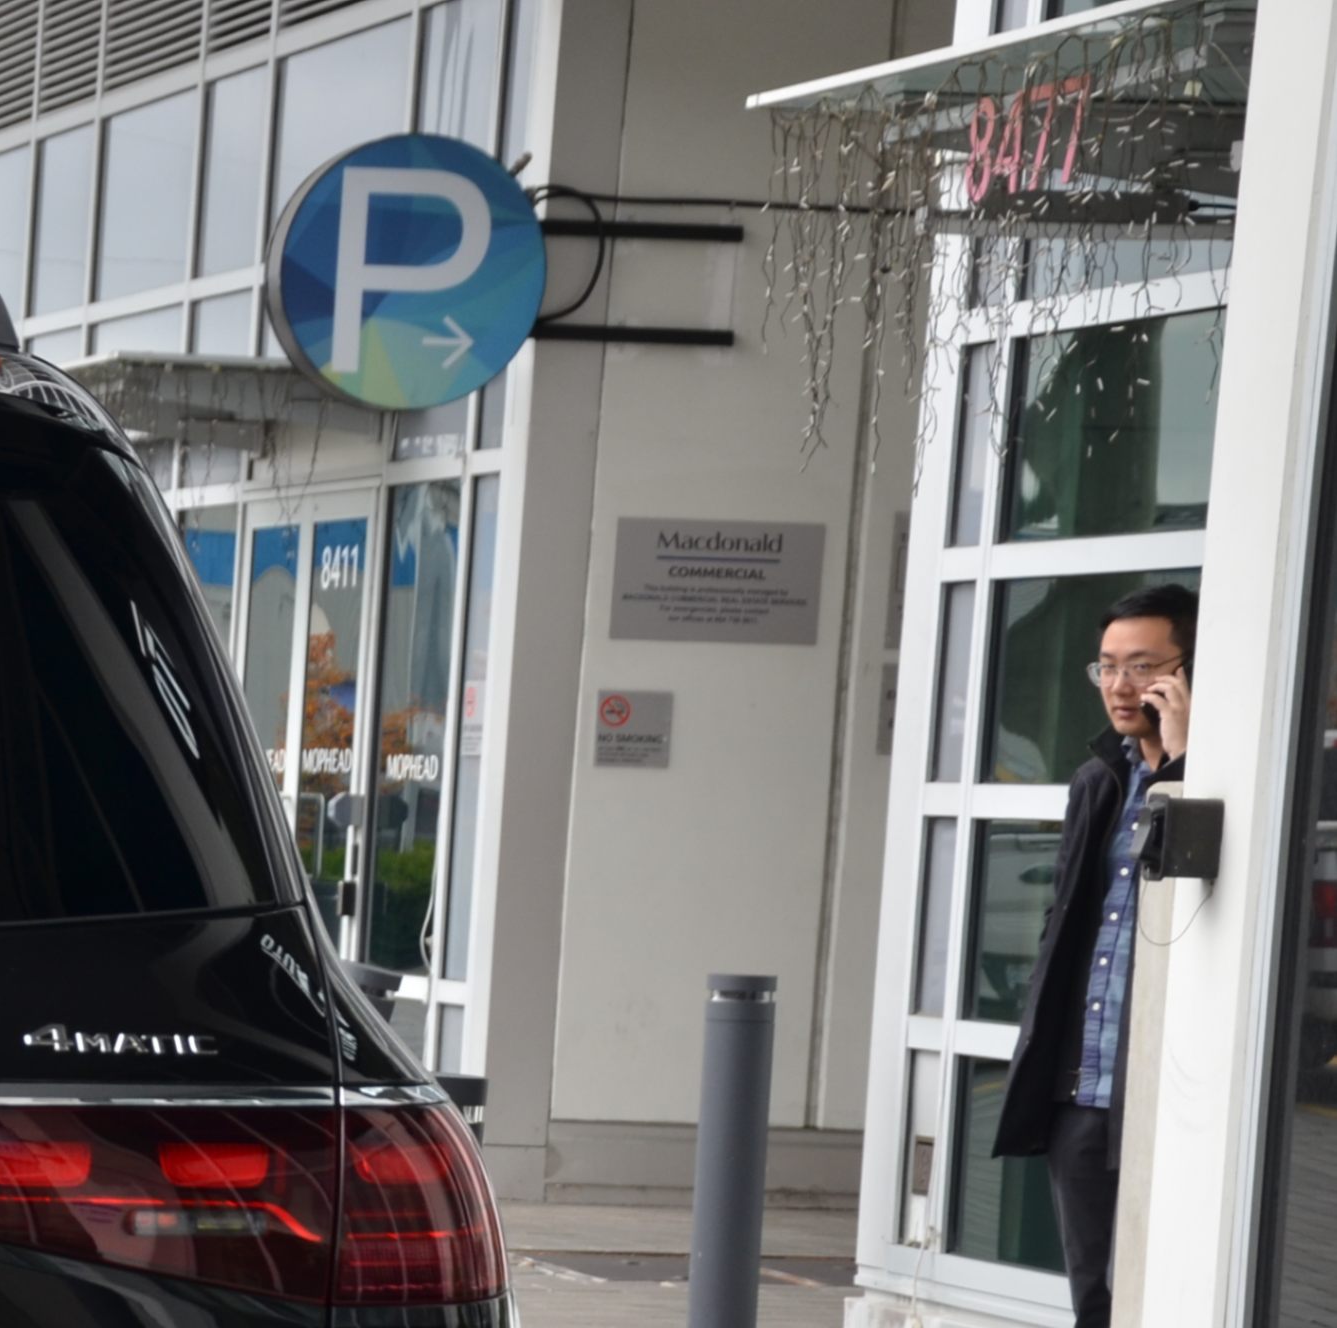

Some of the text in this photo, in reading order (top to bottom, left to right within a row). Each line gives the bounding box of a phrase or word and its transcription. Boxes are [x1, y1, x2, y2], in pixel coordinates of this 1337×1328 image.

[964, 74, 1092, 204] 8477
[331, 166, 492, 373] P
[656, 530, 784, 555] Macdonald
[320, 544, 360, 590] 8411
[667, 565, 767, 581] COMMERCIAL
[615, 733, 663, 744] SMOKING
[385, 754, 439, 781] MOPHEAD
[23, 1023, 220, 1055] 4MATIC
